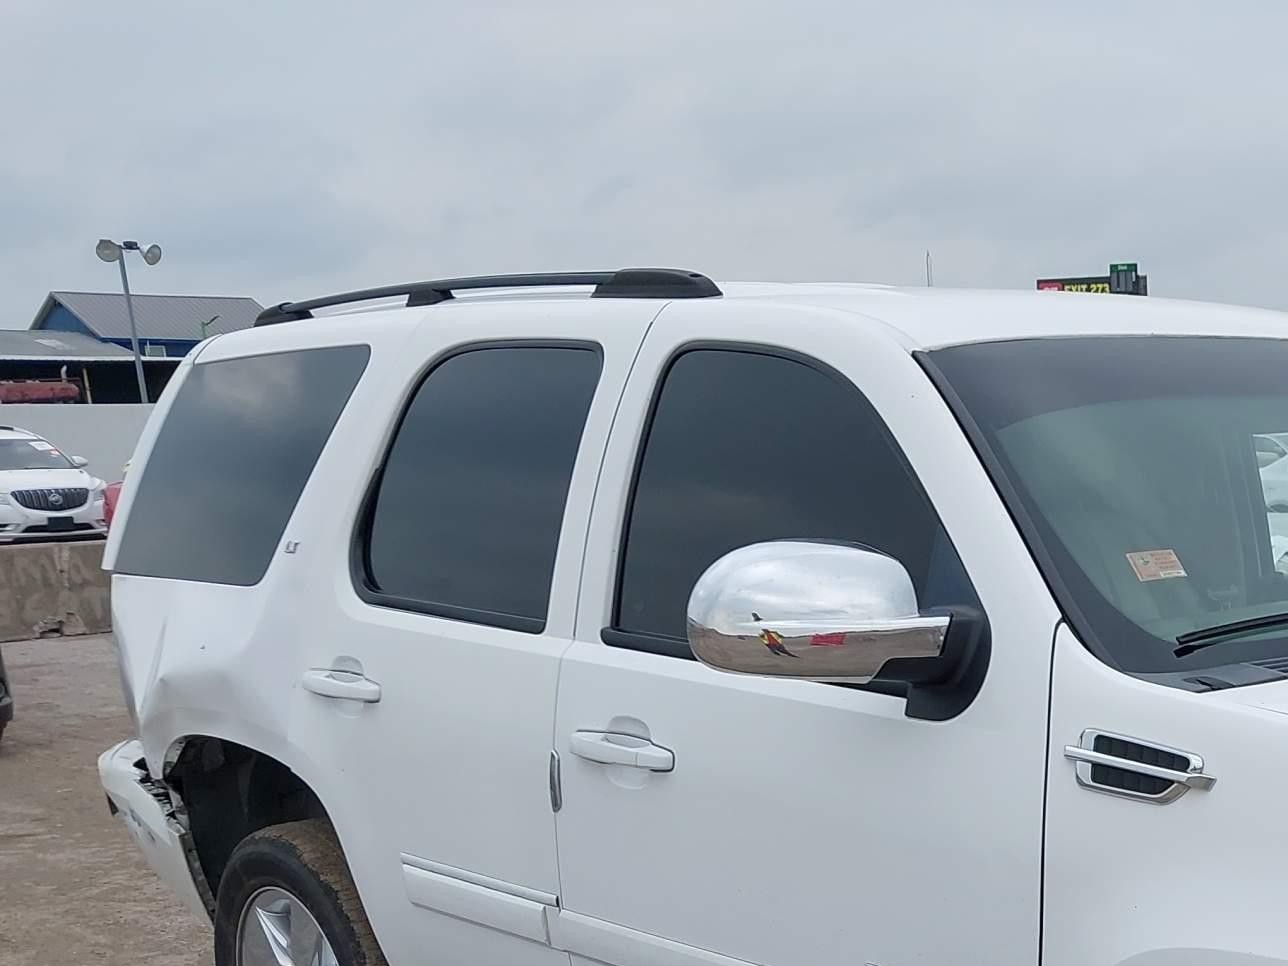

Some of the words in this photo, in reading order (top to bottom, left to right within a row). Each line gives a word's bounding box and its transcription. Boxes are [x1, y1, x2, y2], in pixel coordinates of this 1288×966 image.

[1064, 284, 1088, 293] EXIT
[1090, 283, 1110, 294] 273
[284, 540, 301, 554] LT
